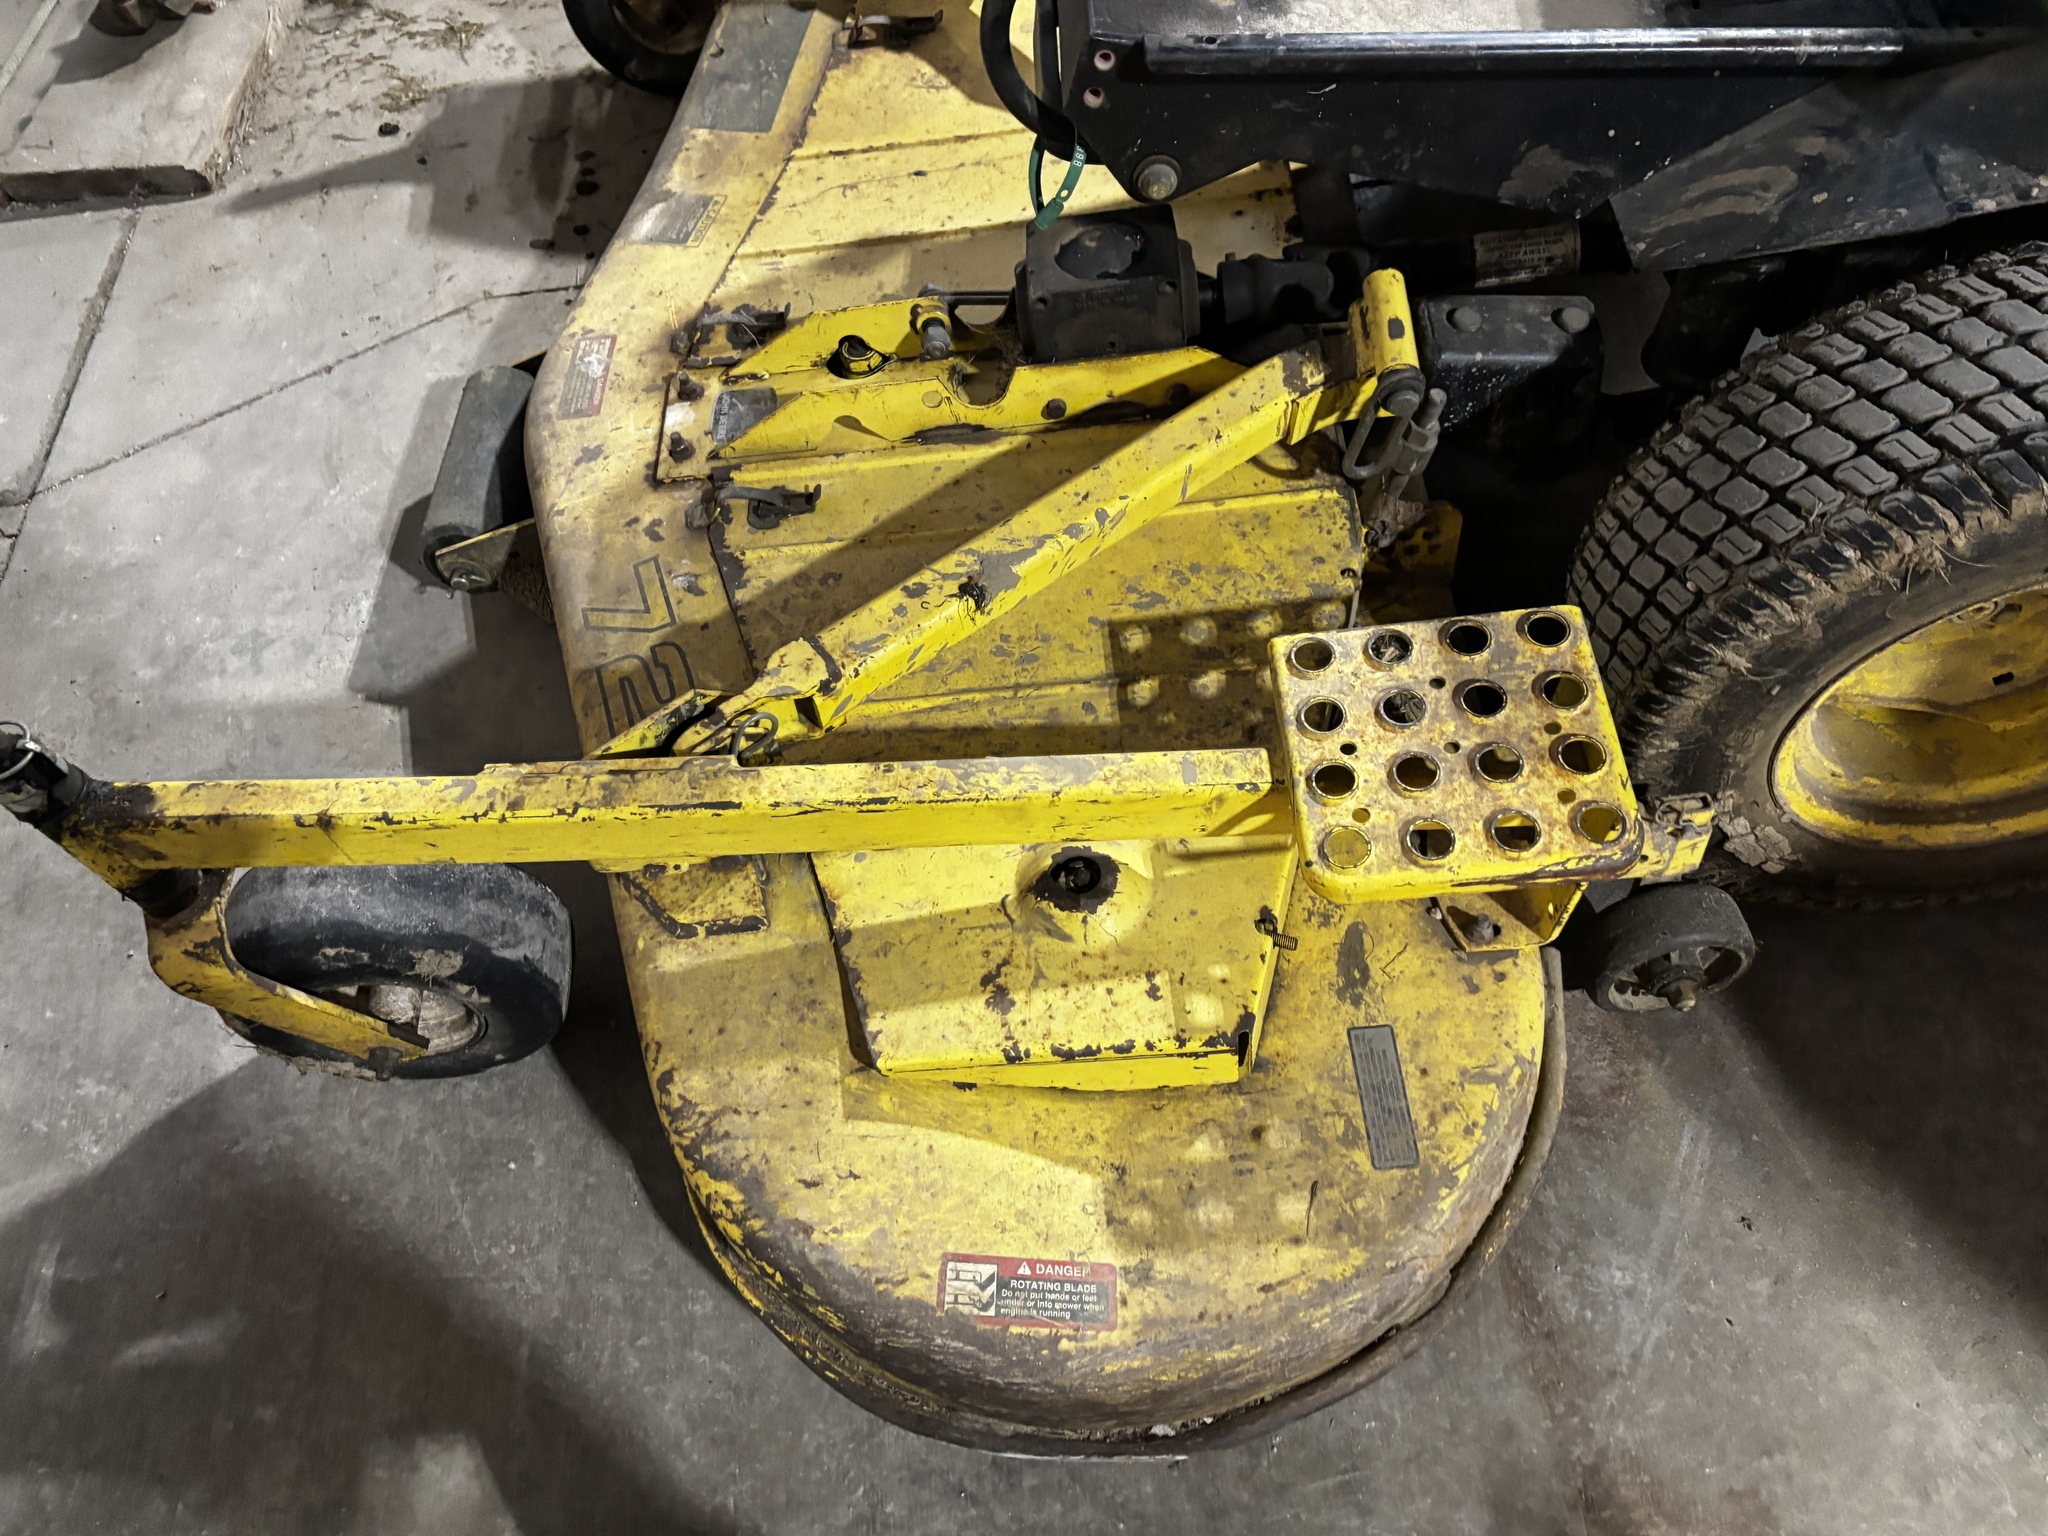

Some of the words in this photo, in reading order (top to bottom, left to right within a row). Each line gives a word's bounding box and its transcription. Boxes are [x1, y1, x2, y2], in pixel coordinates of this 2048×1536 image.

[721, 393, 731, 414] JOHN
[716, 415, 727, 440] DEERE
[1010, 1279, 1061, 1291] ROTATING
[1064, 1283, 1097, 1293] BLADE
[1001, 1289, 1013, 1297] Do
[1030, 1291, 1043, 1300] put
[1045, 1291, 1070, 1300] hands
[1071, 1293, 1080, 1301] or
[1082, 1294, 1097, 1302] feet
[1026, 1300, 1035, 1308] or
[1083, 1302, 1105, 1311] when
[1039, 1309, 1071, 1320] running
